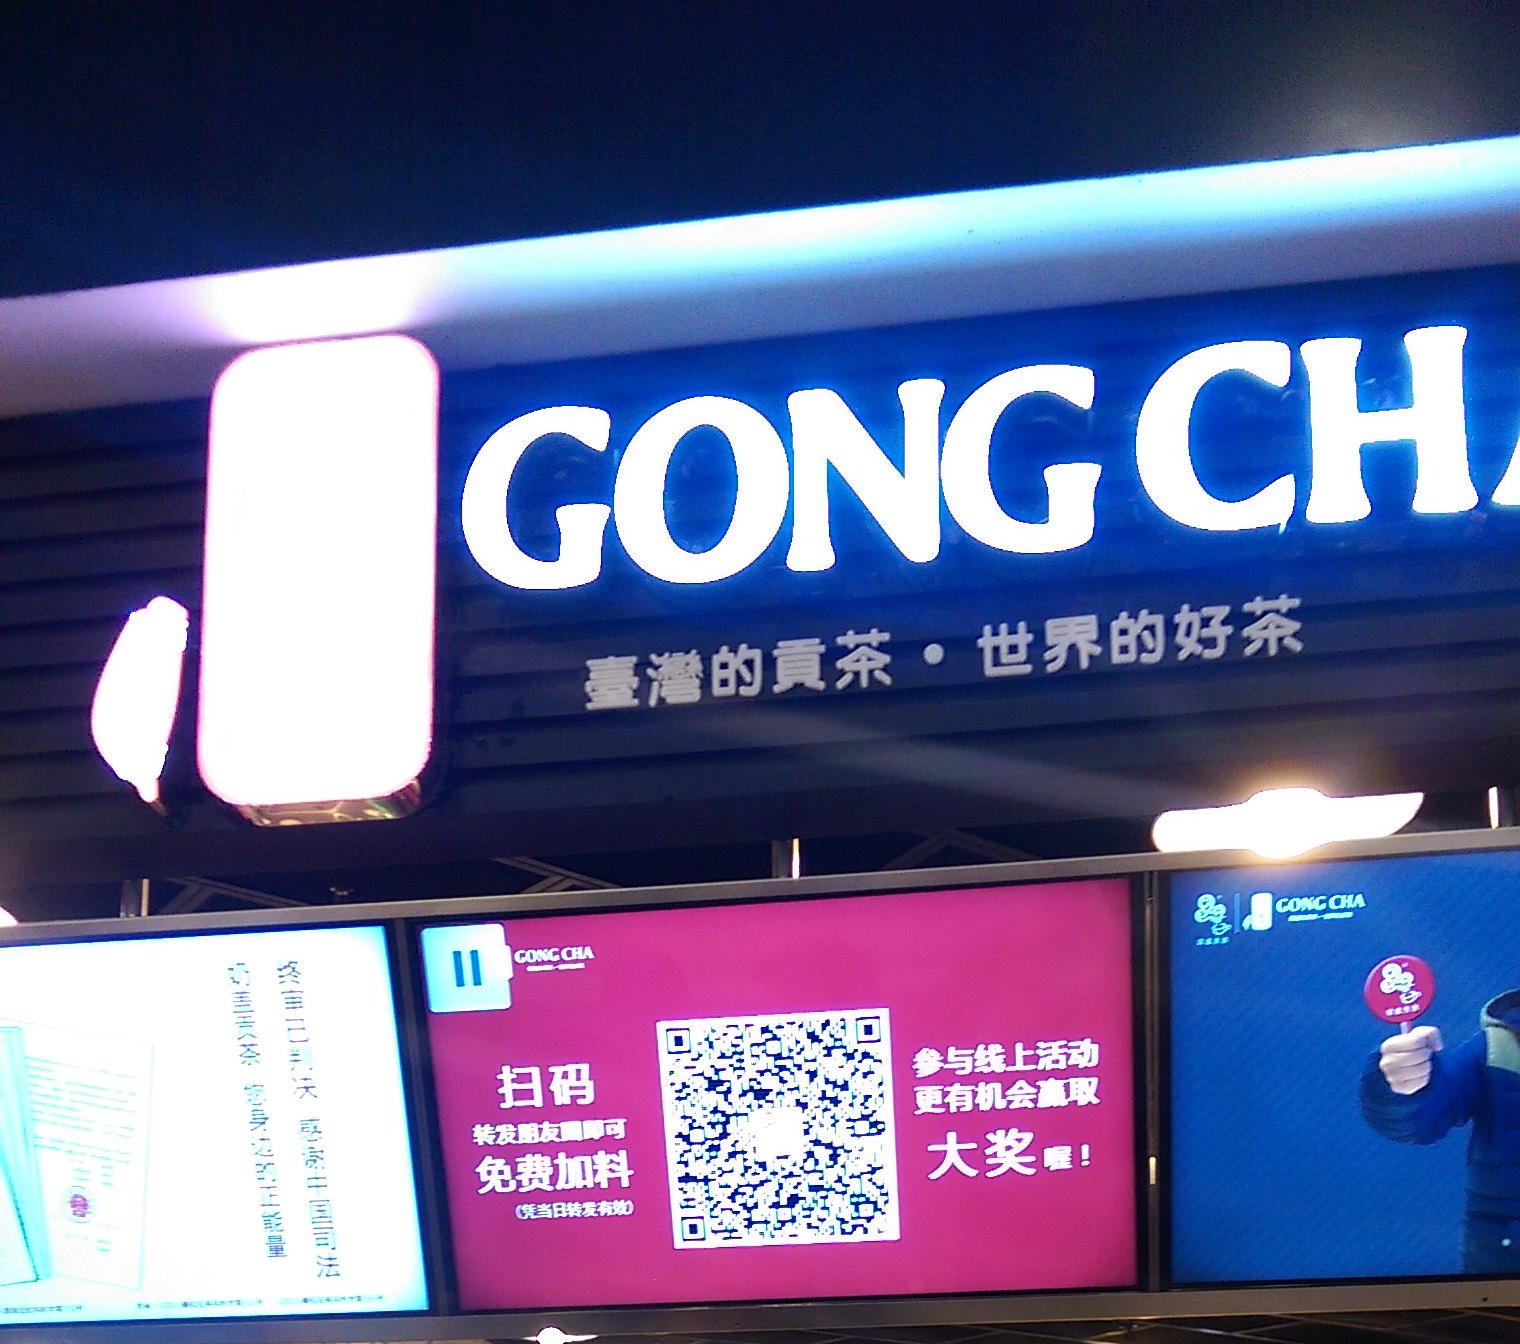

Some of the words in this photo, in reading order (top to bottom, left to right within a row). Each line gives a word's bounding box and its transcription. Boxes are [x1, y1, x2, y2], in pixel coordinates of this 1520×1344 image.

[461, 364, 1102, 590] GONG
[1135, 325, 1520, 532] CH
[1275, 896, 1327, 913] GONG
[1328, 893, 1367, 909] CHA
[513, 948, 560, 963] GONG
[561, 945, 595, 961] CHA
[912, 1037, 1100, 1079] 参与线上活动
[496, 1063, 595, 1109] 扫码
[913, 1076, 1101, 1115] 更有机会赢取
[475, 1149, 635, 1195] 免费加料
